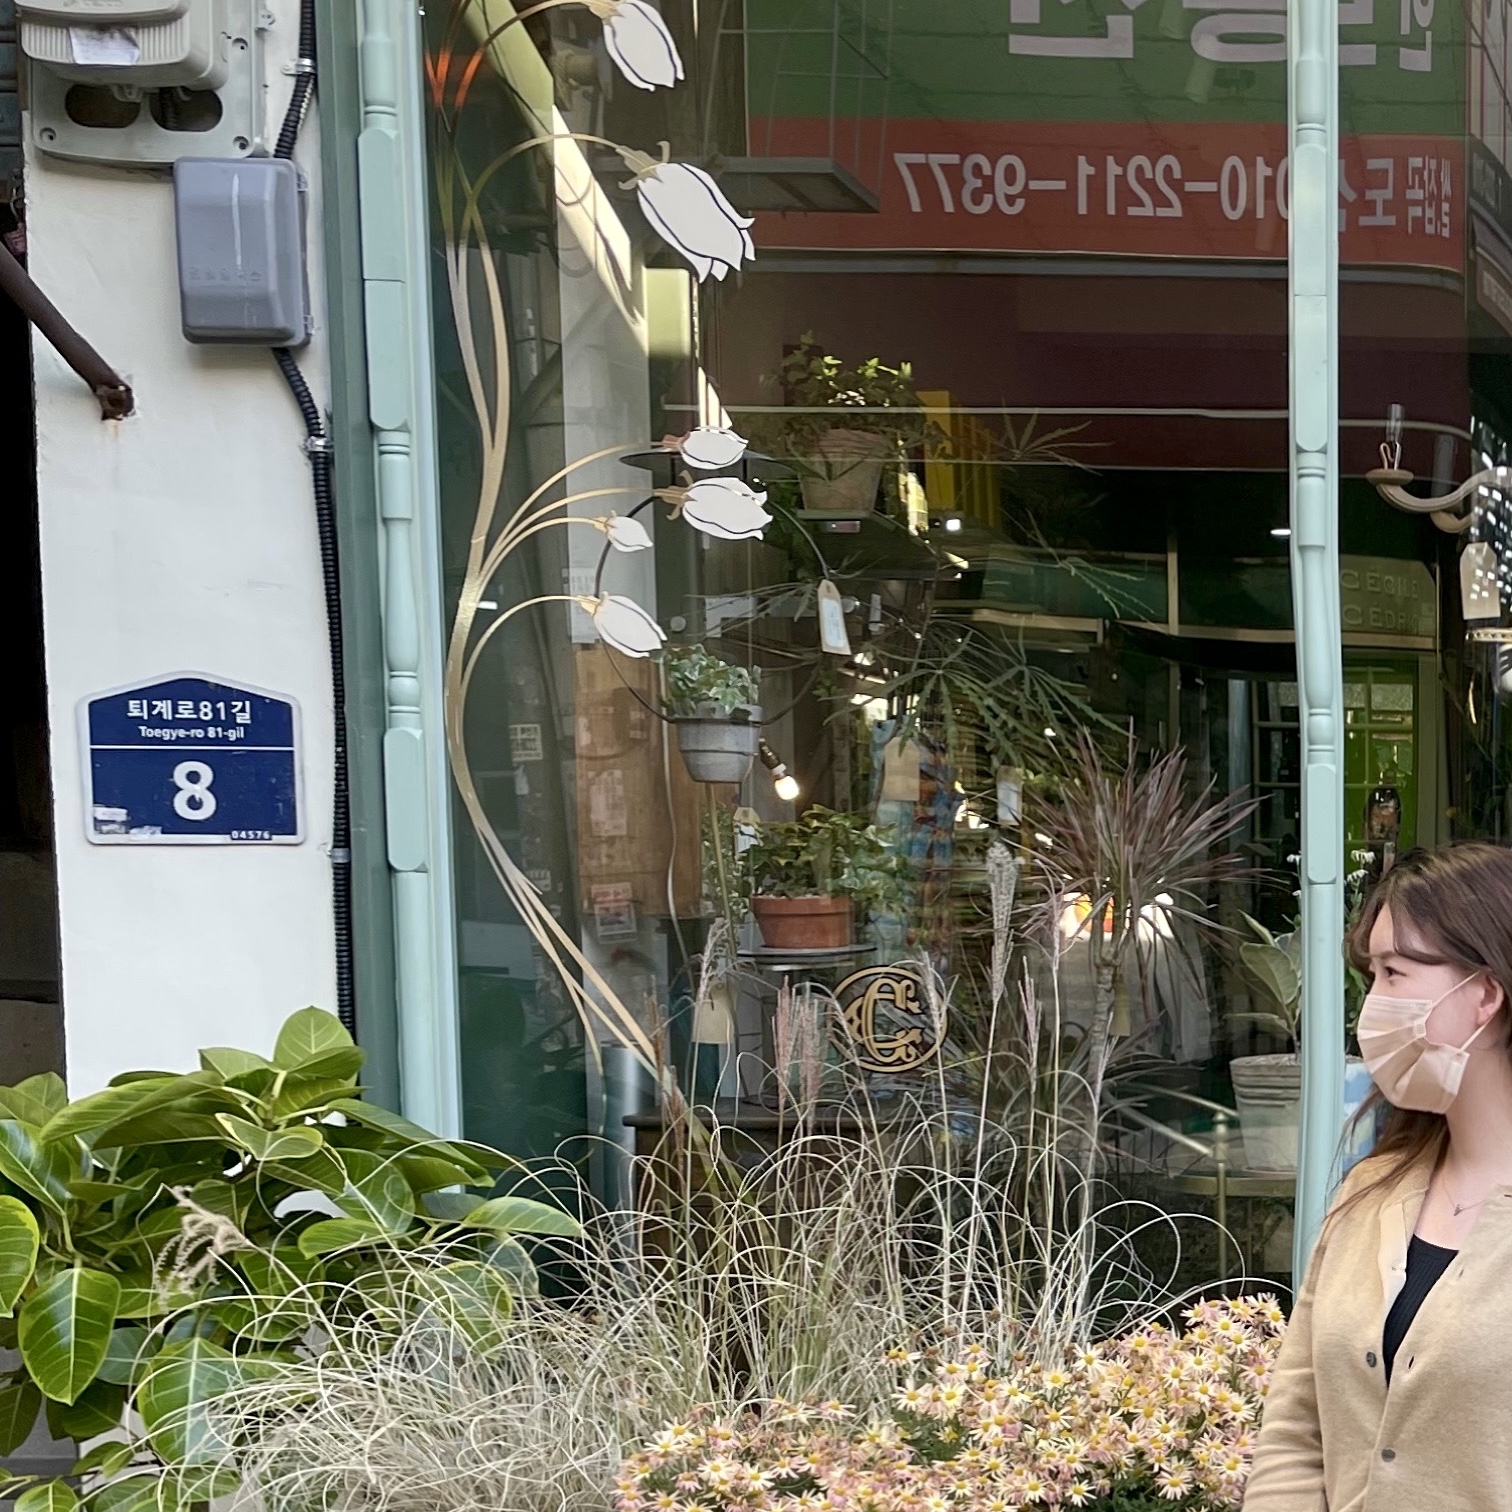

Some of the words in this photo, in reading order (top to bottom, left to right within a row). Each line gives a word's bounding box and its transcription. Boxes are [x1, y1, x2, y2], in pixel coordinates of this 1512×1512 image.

[127, 699, 251, 724] 퇴계로81길
[138, 726, 205, 740] Toegye-ro
[207, 727, 244, 741] 81-gil
[172, 760, 217, 821] 8
[230, 830, 271, 840] 04576
